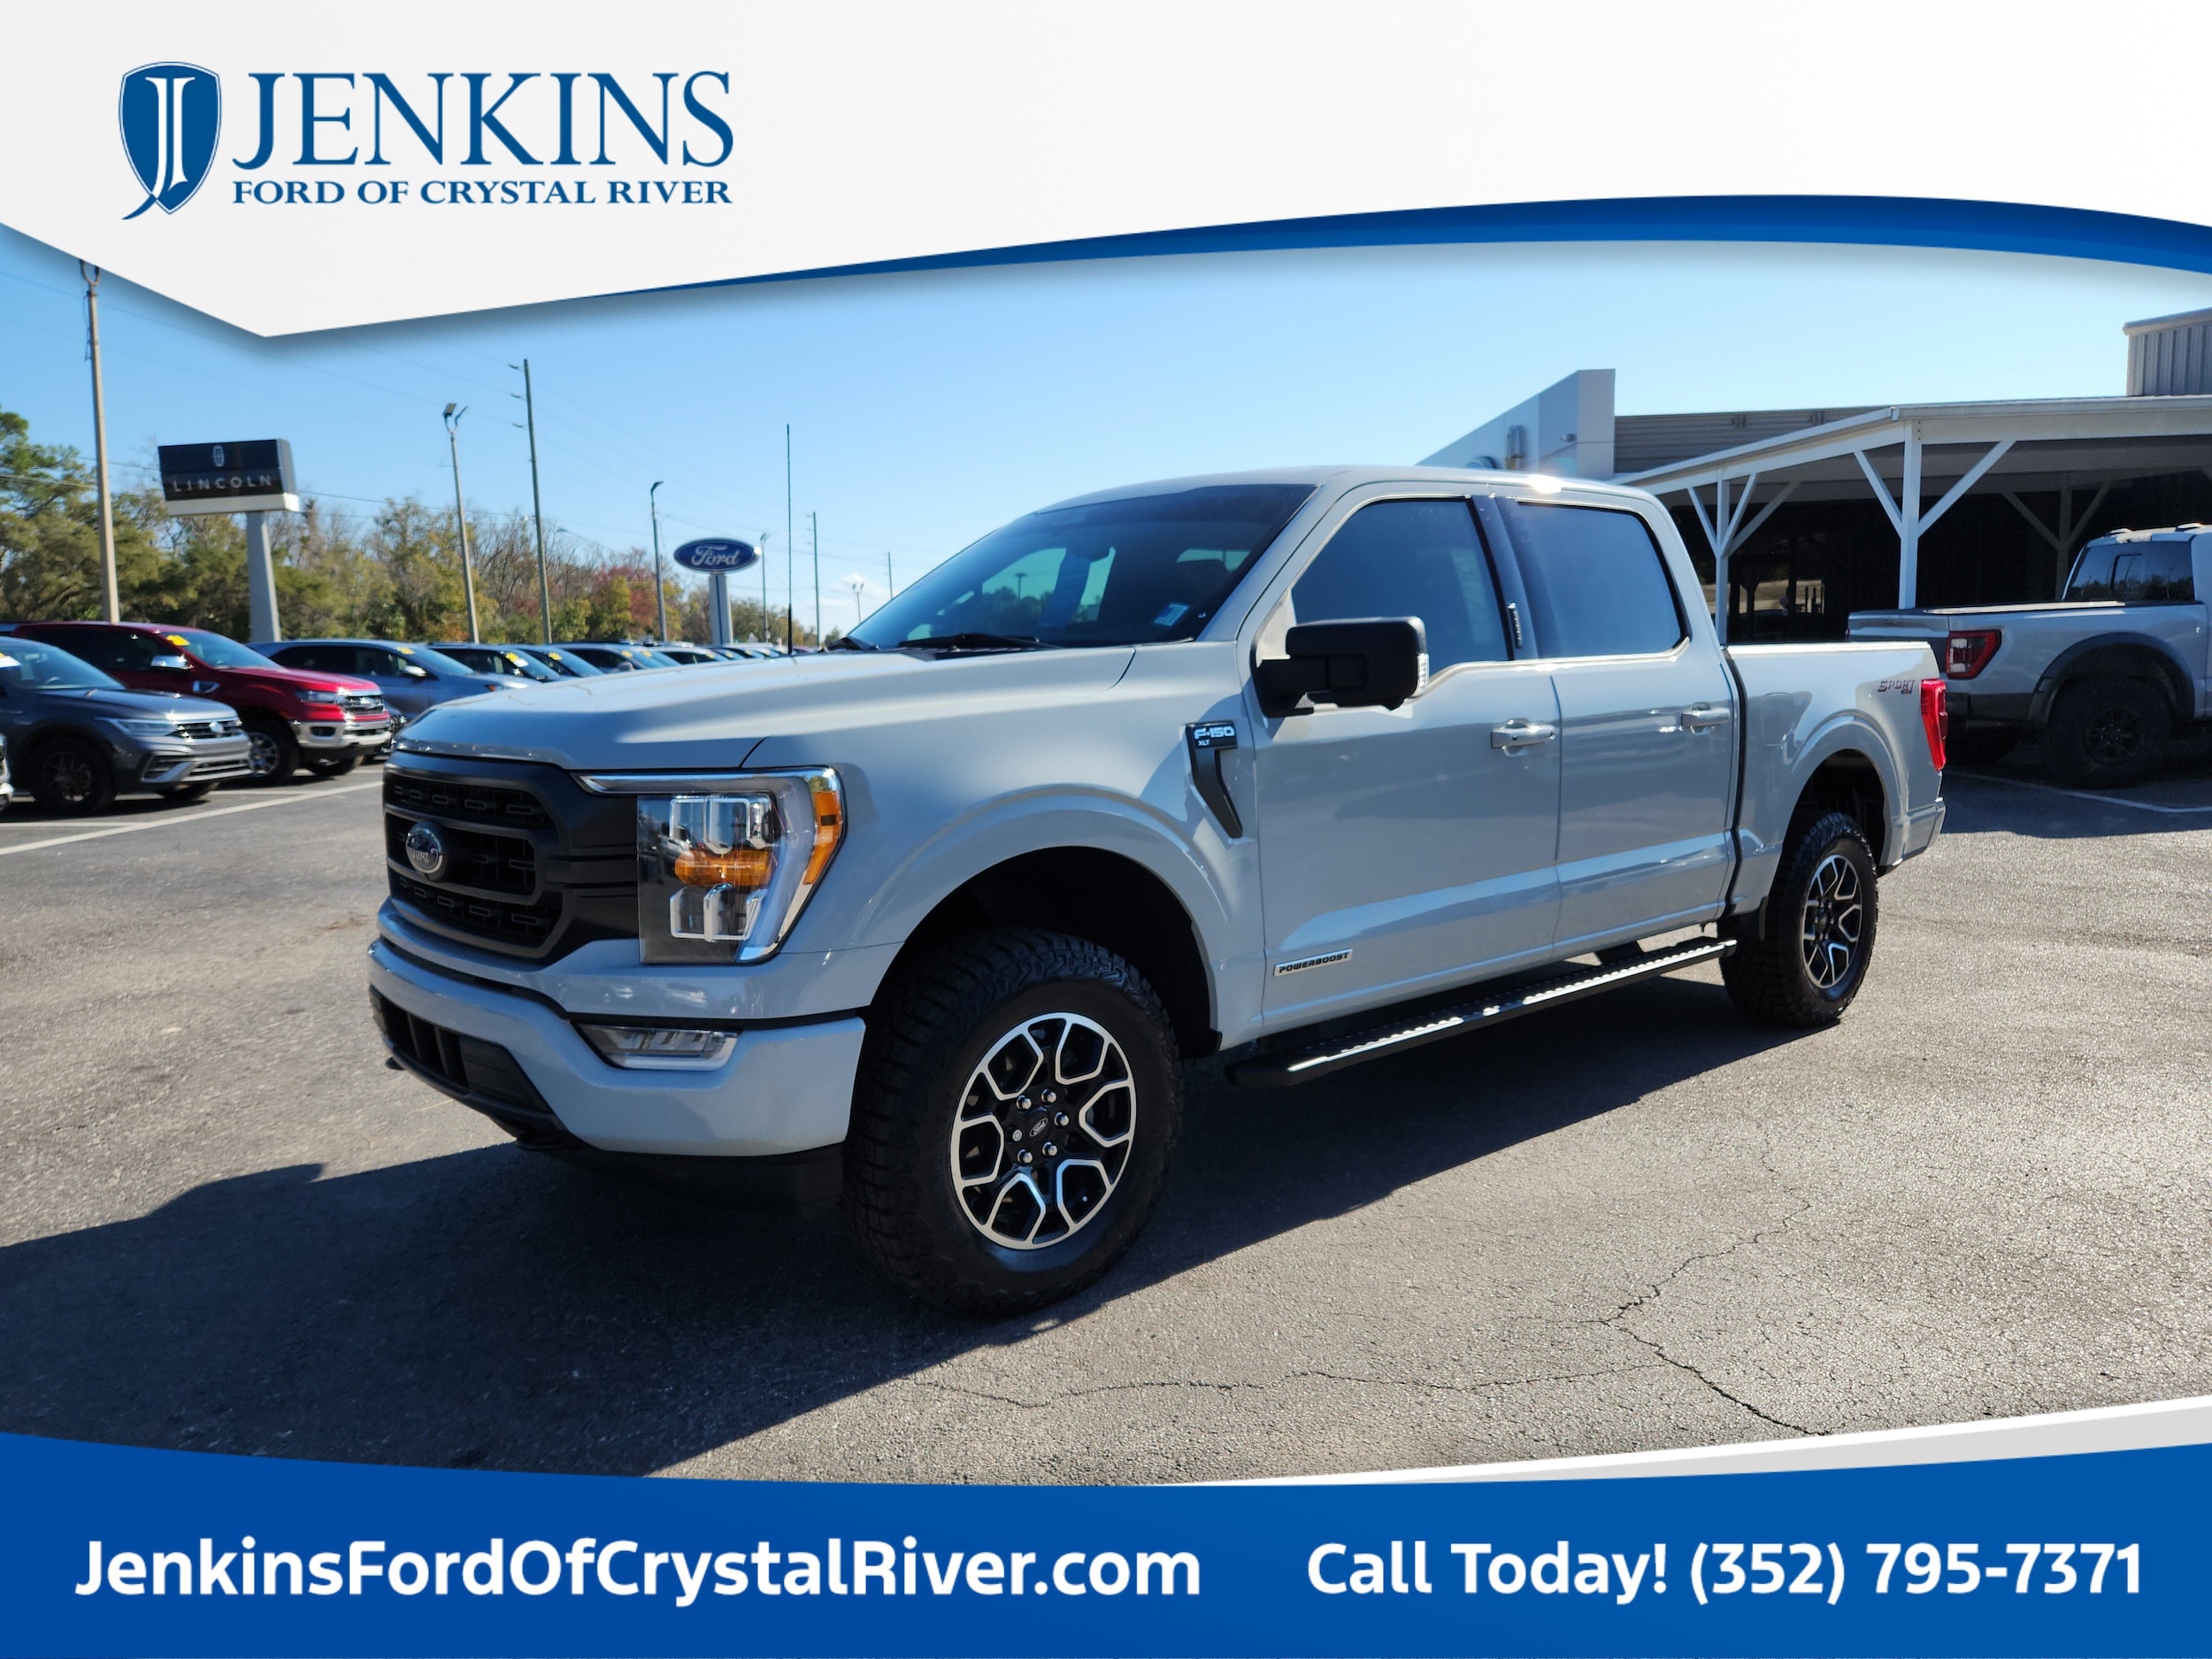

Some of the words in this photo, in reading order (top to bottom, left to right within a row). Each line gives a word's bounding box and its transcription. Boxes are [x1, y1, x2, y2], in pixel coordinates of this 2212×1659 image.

[173, 474, 272, 493] LINCOLN
[691, 544, 740, 565] Ford
[1194, 726, 1235, 740] F-150
[1279, 952, 1349, 973] POWERBOOST
